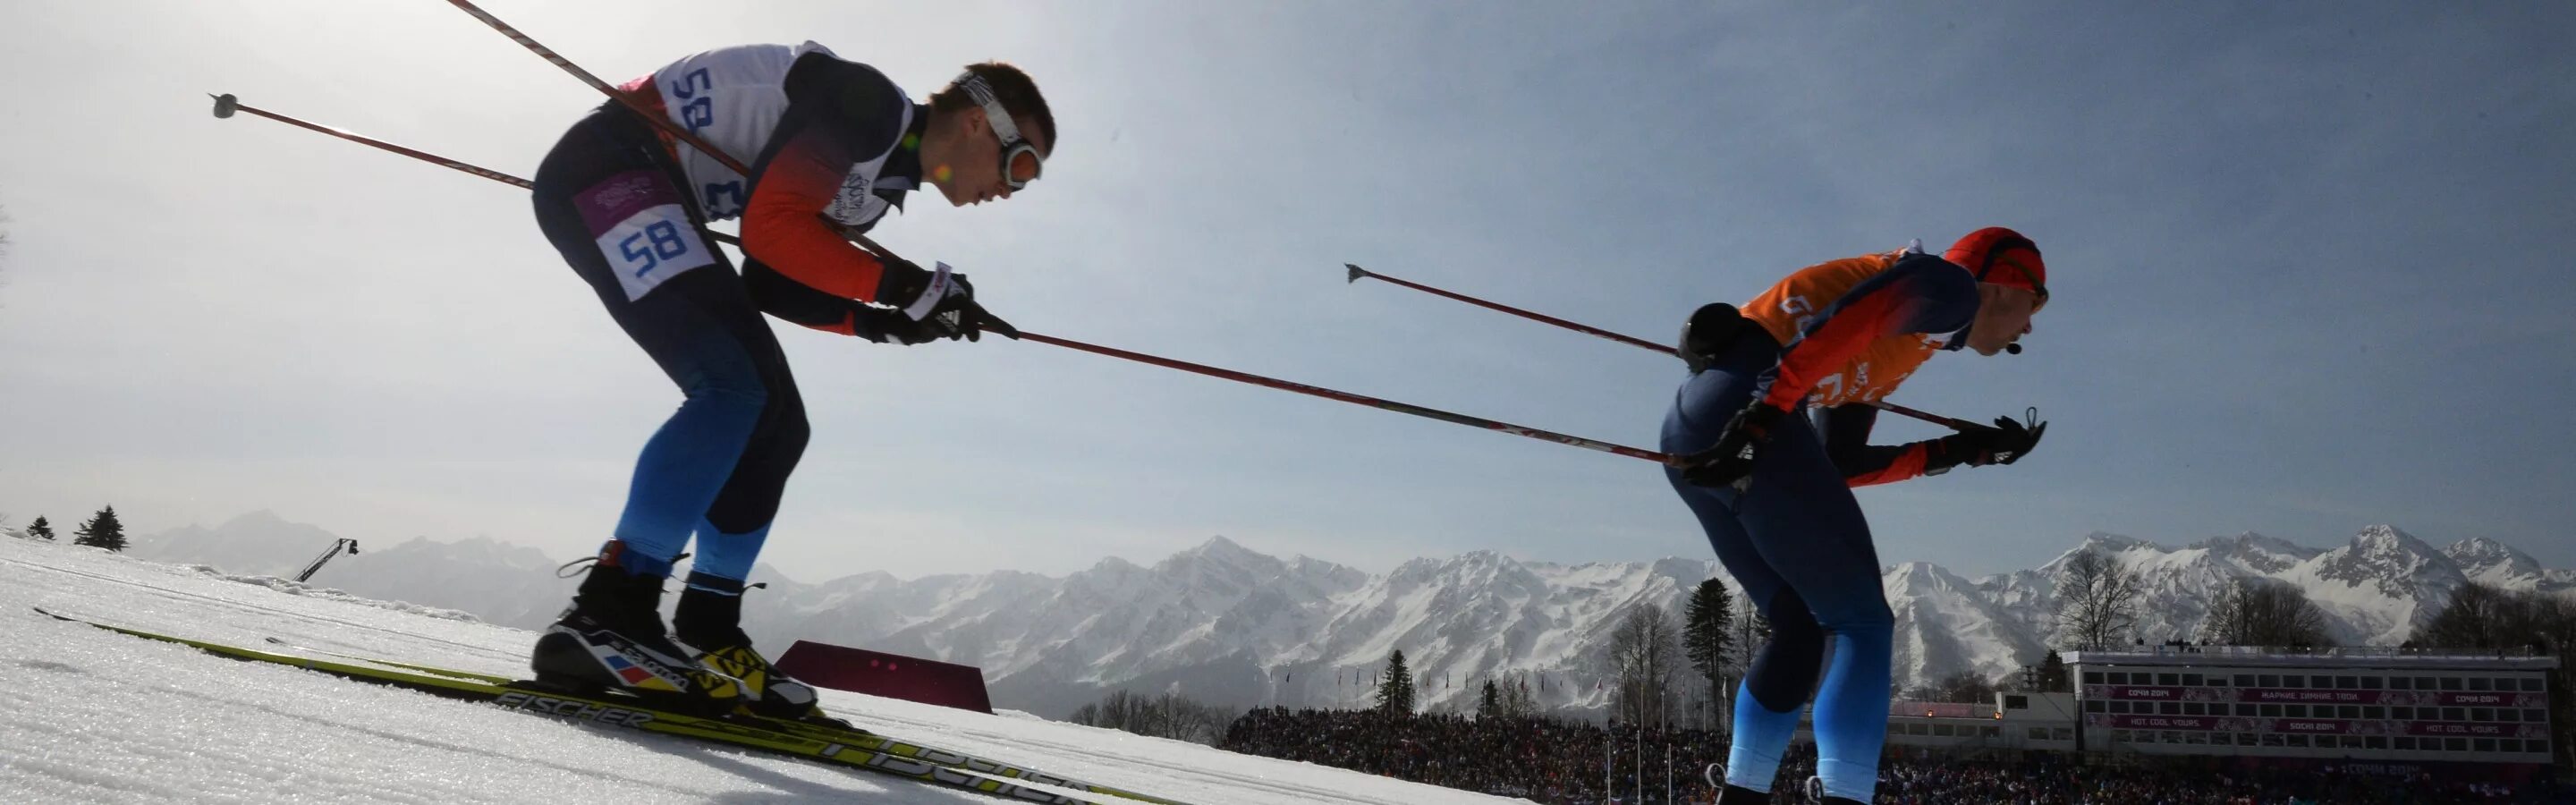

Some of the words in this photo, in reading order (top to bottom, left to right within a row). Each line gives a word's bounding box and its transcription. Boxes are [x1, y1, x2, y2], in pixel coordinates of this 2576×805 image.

[673, 67, 712, 133] 58
[619, 220, 688, 277] 58
[495, 692, 657, 727] FISCHER
[2480, 695, 2500, 703] 2014
